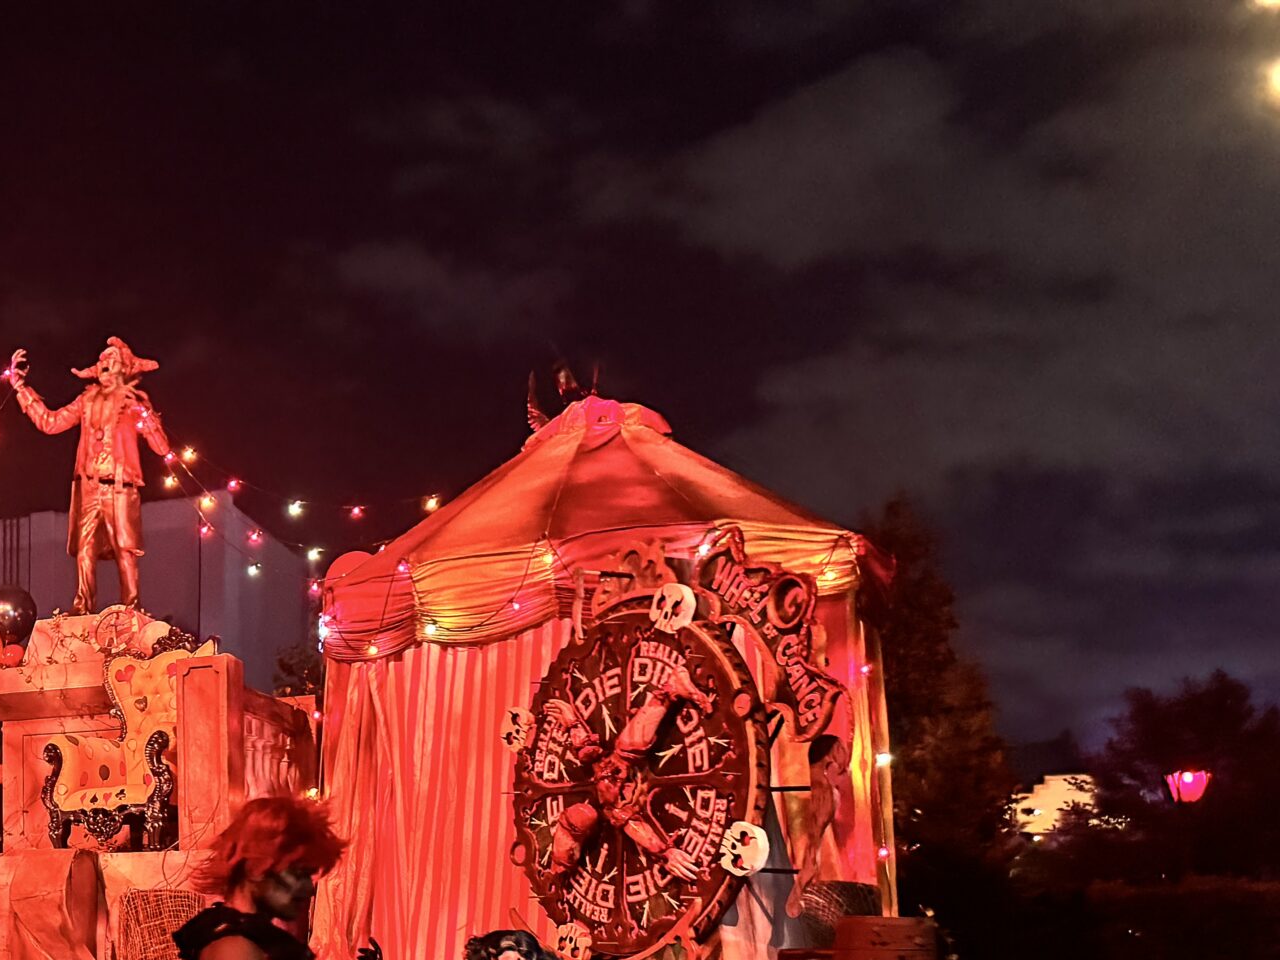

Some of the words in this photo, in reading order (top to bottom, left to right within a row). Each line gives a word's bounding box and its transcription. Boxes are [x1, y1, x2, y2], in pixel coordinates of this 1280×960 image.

[575, 667, 622, 720] DIE
[676, 708, 709, 773] DIE
[680, 788, 716, 863] DIE
[699, 798, 727, 867] REALLY
[564, 888, 610, 922] REALLY
[570, 866, 615, 909] DIE
[625, 863, 673, 903] DIE
